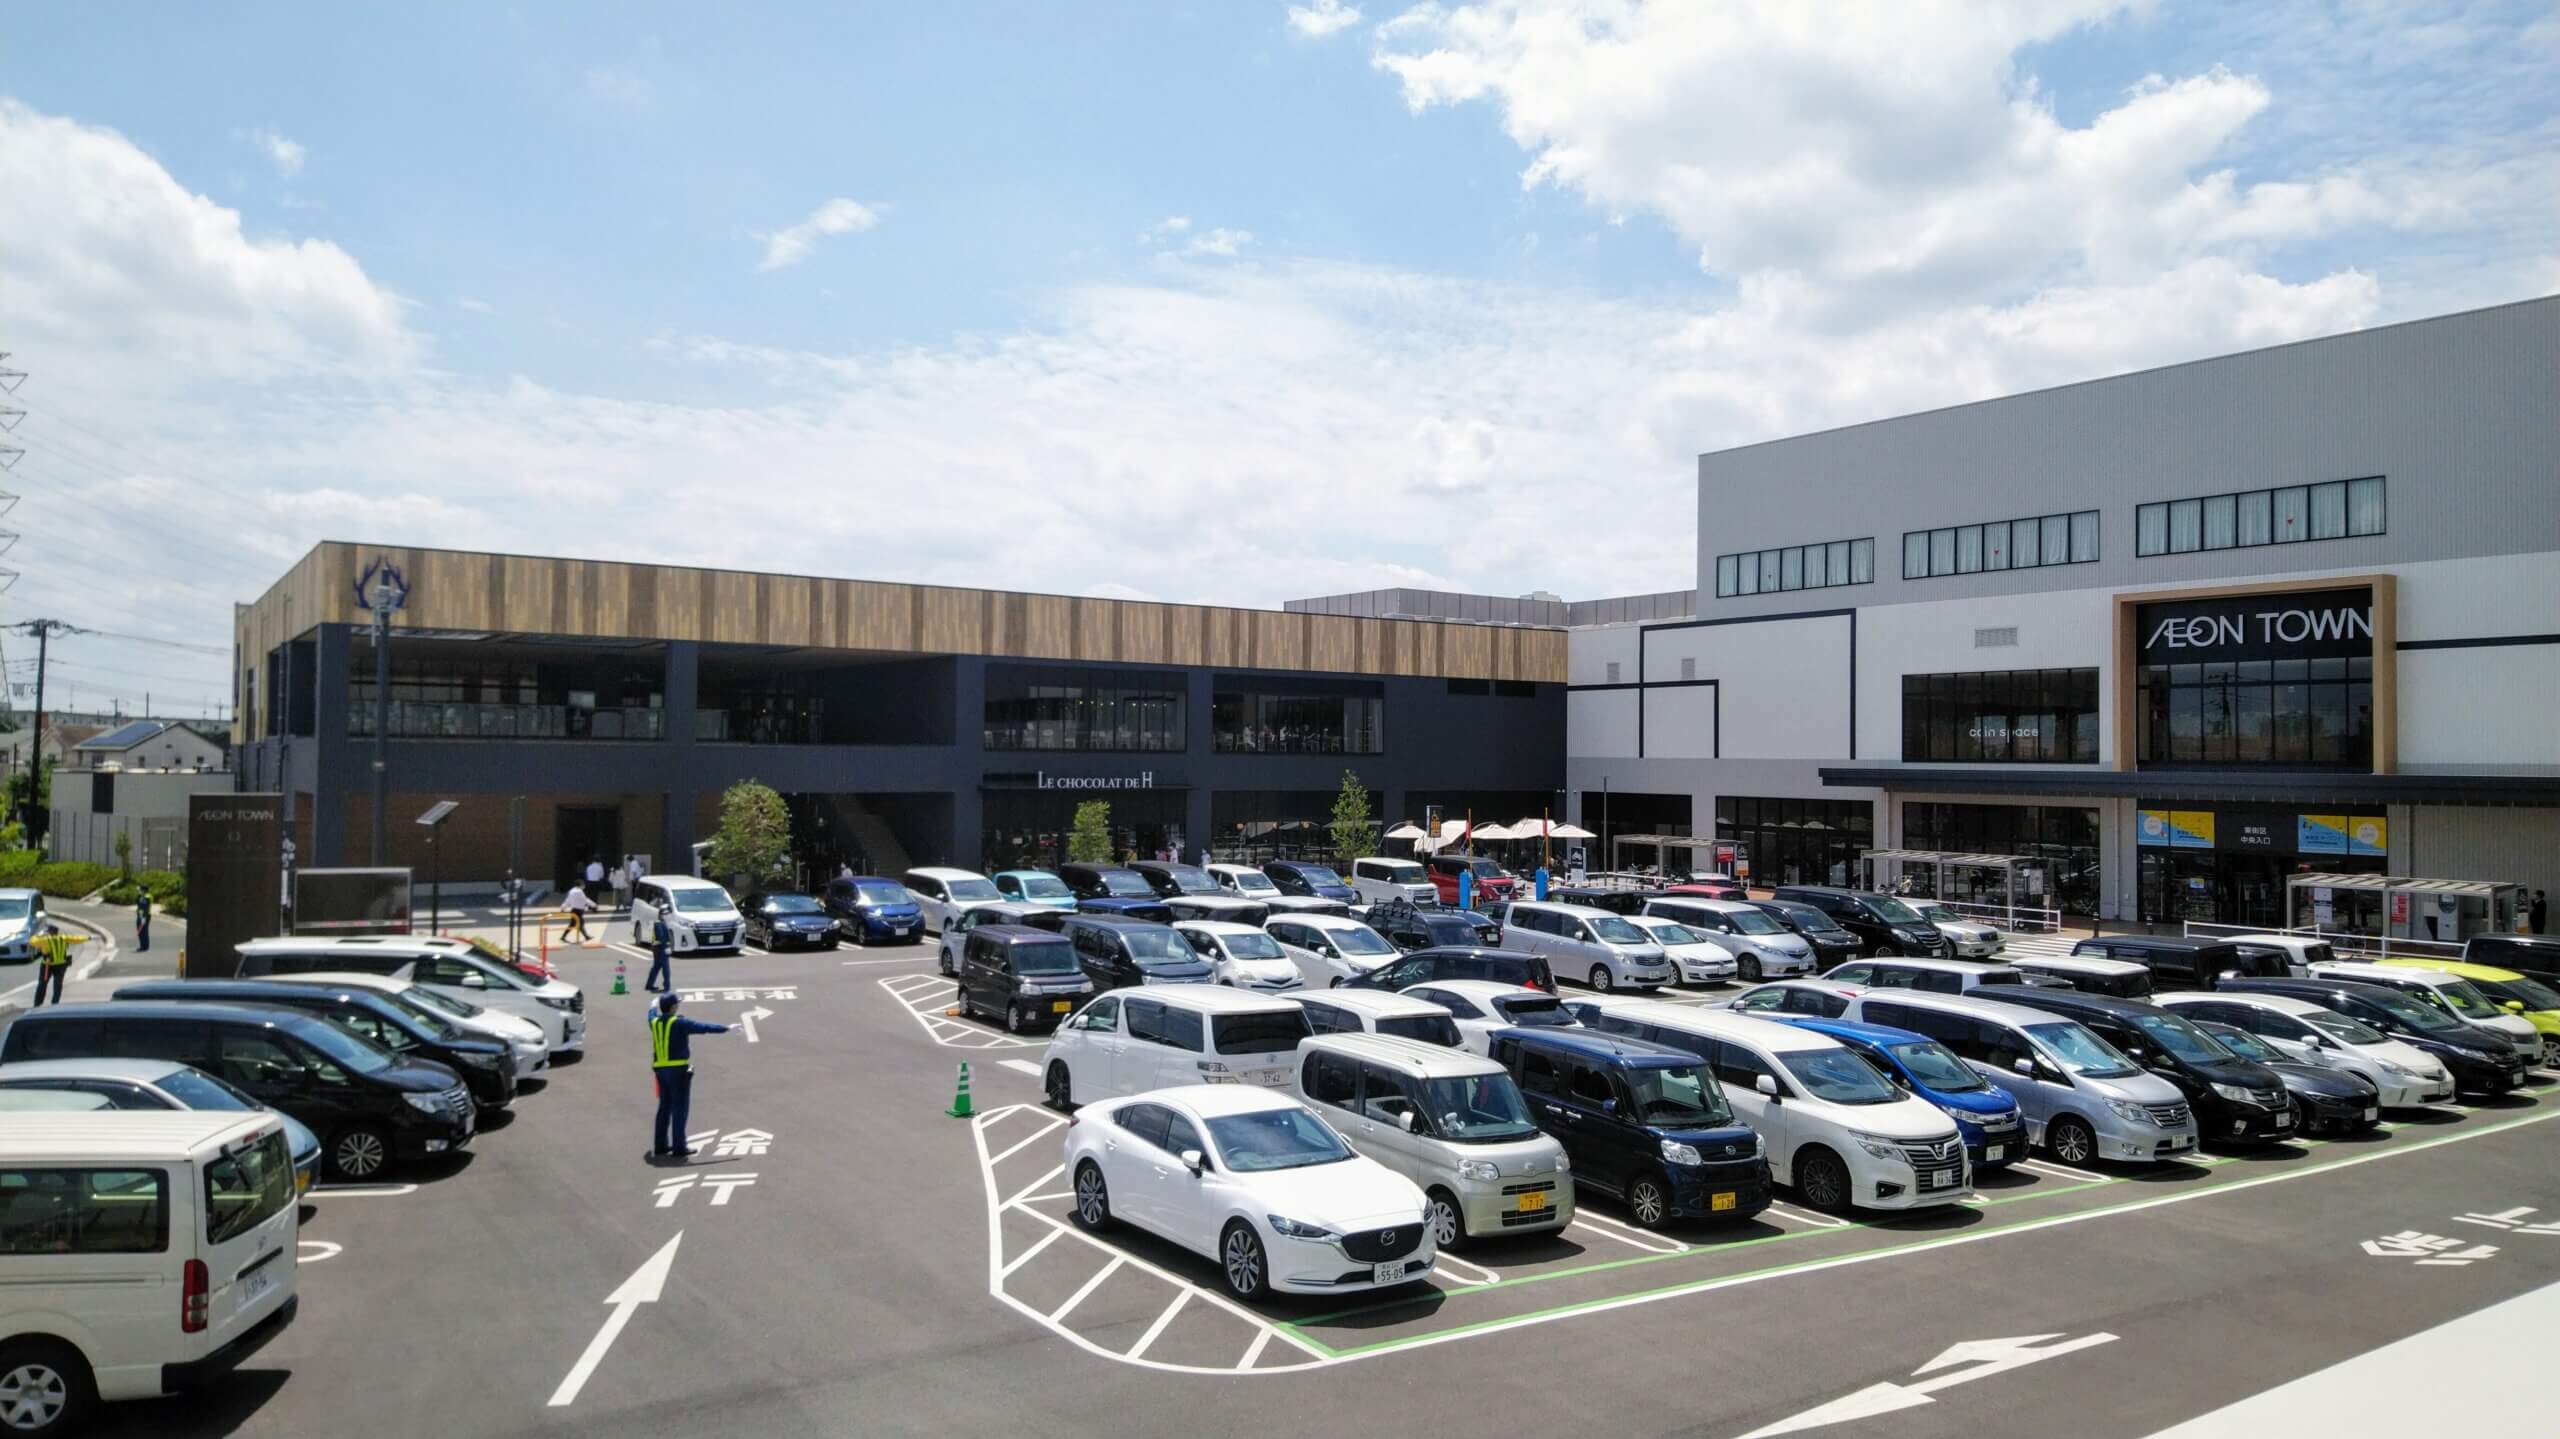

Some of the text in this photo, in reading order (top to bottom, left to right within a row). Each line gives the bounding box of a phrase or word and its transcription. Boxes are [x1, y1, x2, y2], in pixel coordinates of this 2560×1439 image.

[2255, 606, 2374, 644] TOWN
[1142, 771, 1152, 789] H
[2240, 836, 2271, 845] 中央入口
